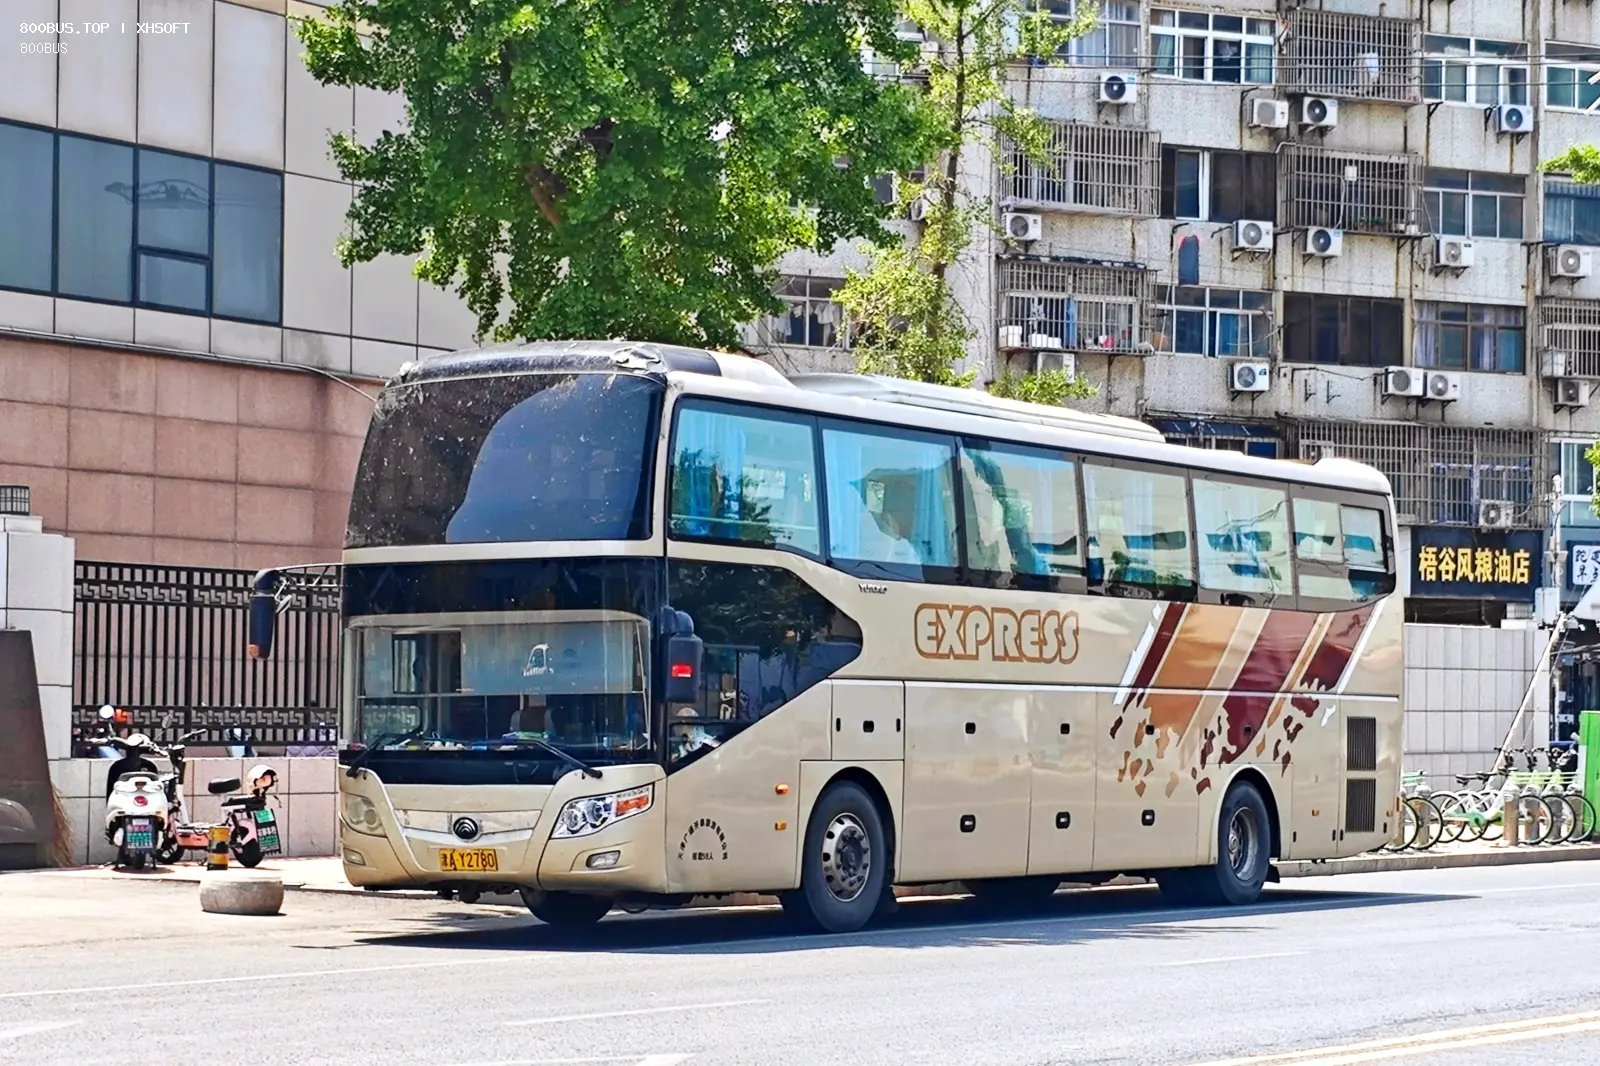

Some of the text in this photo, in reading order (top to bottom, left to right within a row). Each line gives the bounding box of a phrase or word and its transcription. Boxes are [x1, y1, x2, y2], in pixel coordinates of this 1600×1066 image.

[1418, 545, 1530, 584] 梧谷风粮油店
[914, 603, 1079, 664] EXPRESS
